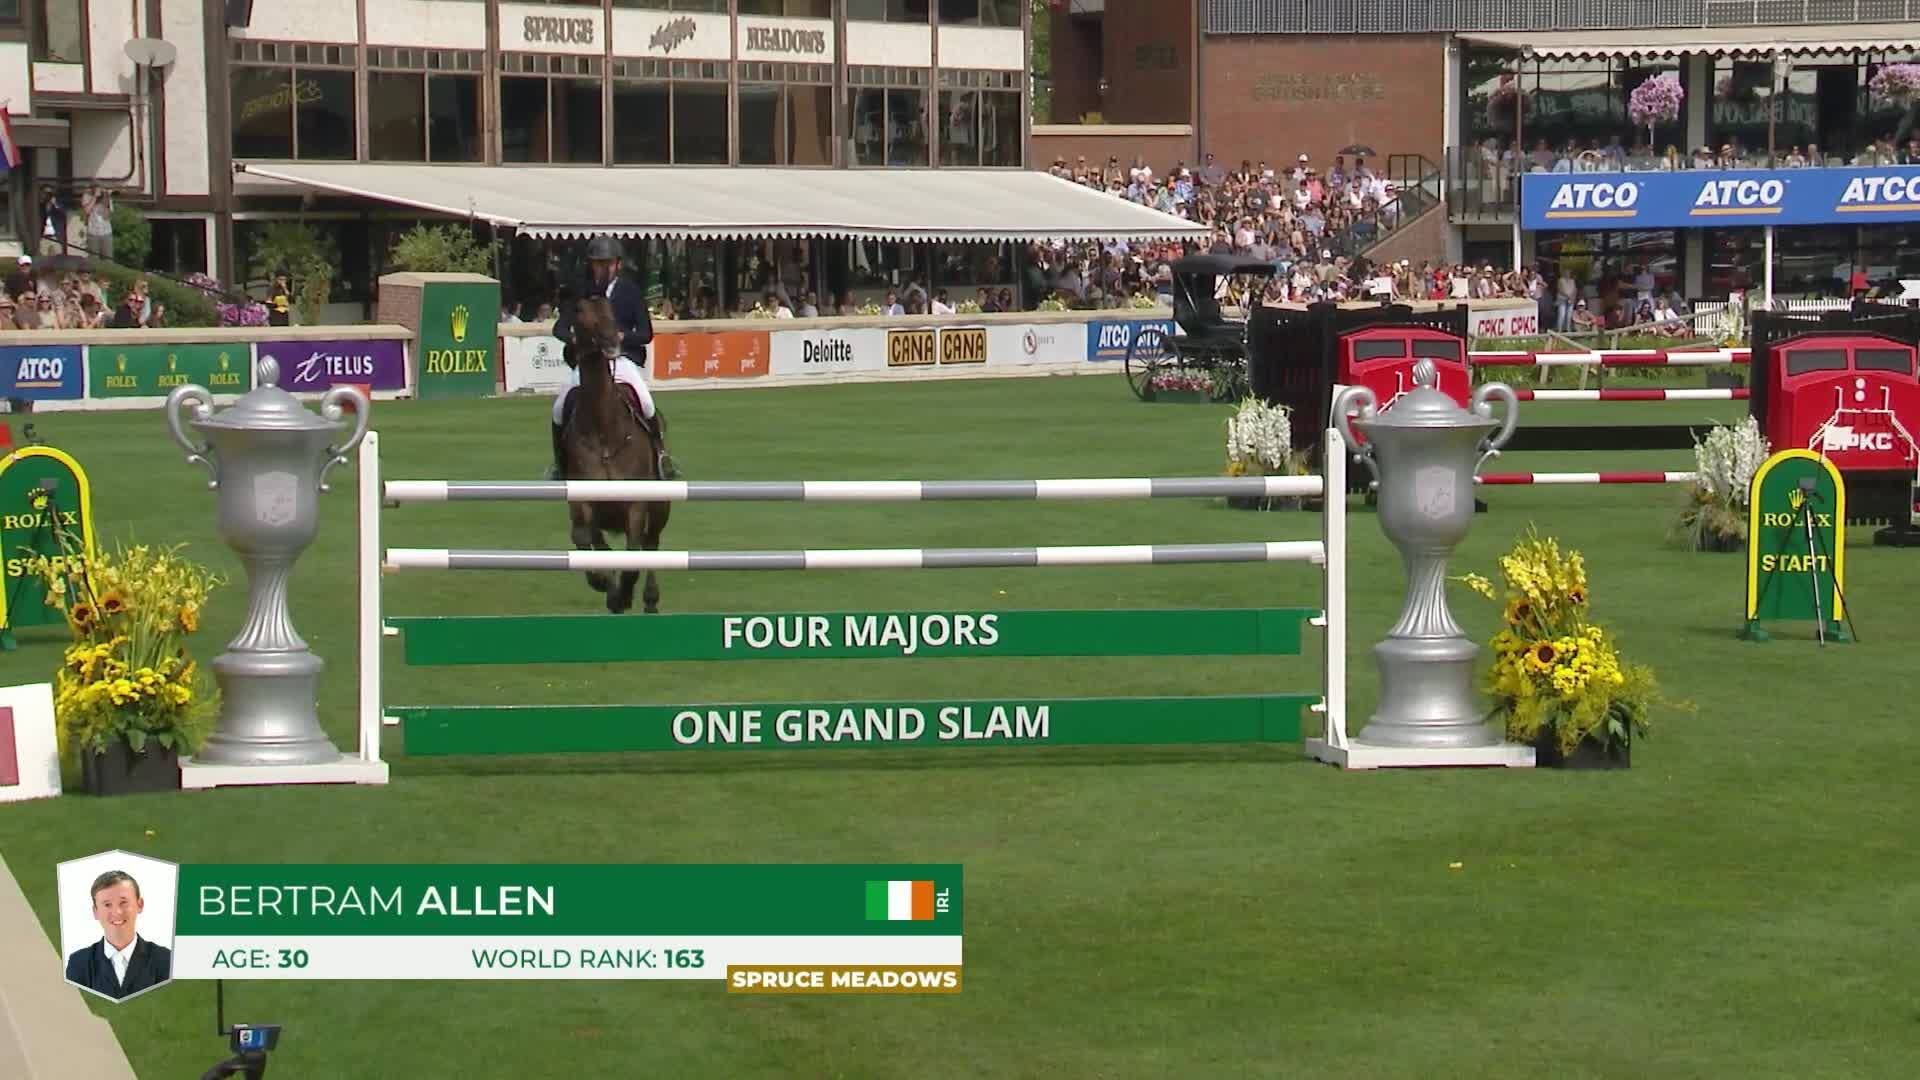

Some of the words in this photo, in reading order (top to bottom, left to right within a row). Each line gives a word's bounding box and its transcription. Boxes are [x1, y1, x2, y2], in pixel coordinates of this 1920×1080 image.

[523, 16, 593, 44] SPRUCE
[746, 27, 826, 54] MEADOWS
[1550, 183, 1638, 209] ATCO
[1695, 180, 1784, 206] ATCO
[1098, 324, 1131, 348] ATCO
[1511, 315, 1536, 335] CPKC
[803, 339, 852, 363] Deloitte
[892, 335, 934, 361] CANA
[944, 332, 984, 359] CANA
[16, 357, 64, 381] ATCO
[325, 356, 374, 376] TELUS
[426, 350, 488, 374] ROLEX
[667, 359, 683, 375] pwc
[704, 358, 720, 374] pwc
[740, 357, 756, 374] pwc
[106, 375, 138, 389] ROLEX
[158, 374, 191, 387] ROLEX
[209, 373, 241, 386] ROLEX
[4, 512, 78, 529] ROLX
[1761, 553, 1830, 572] START
[722, 615, 832, 649] FOUR
[844, 614, 999, 654] MAJORS
[672, 710, 762, 744] ONE
[775, 707, 925, 742] GRAND
[938, 706, 1050, 740] SLAM
